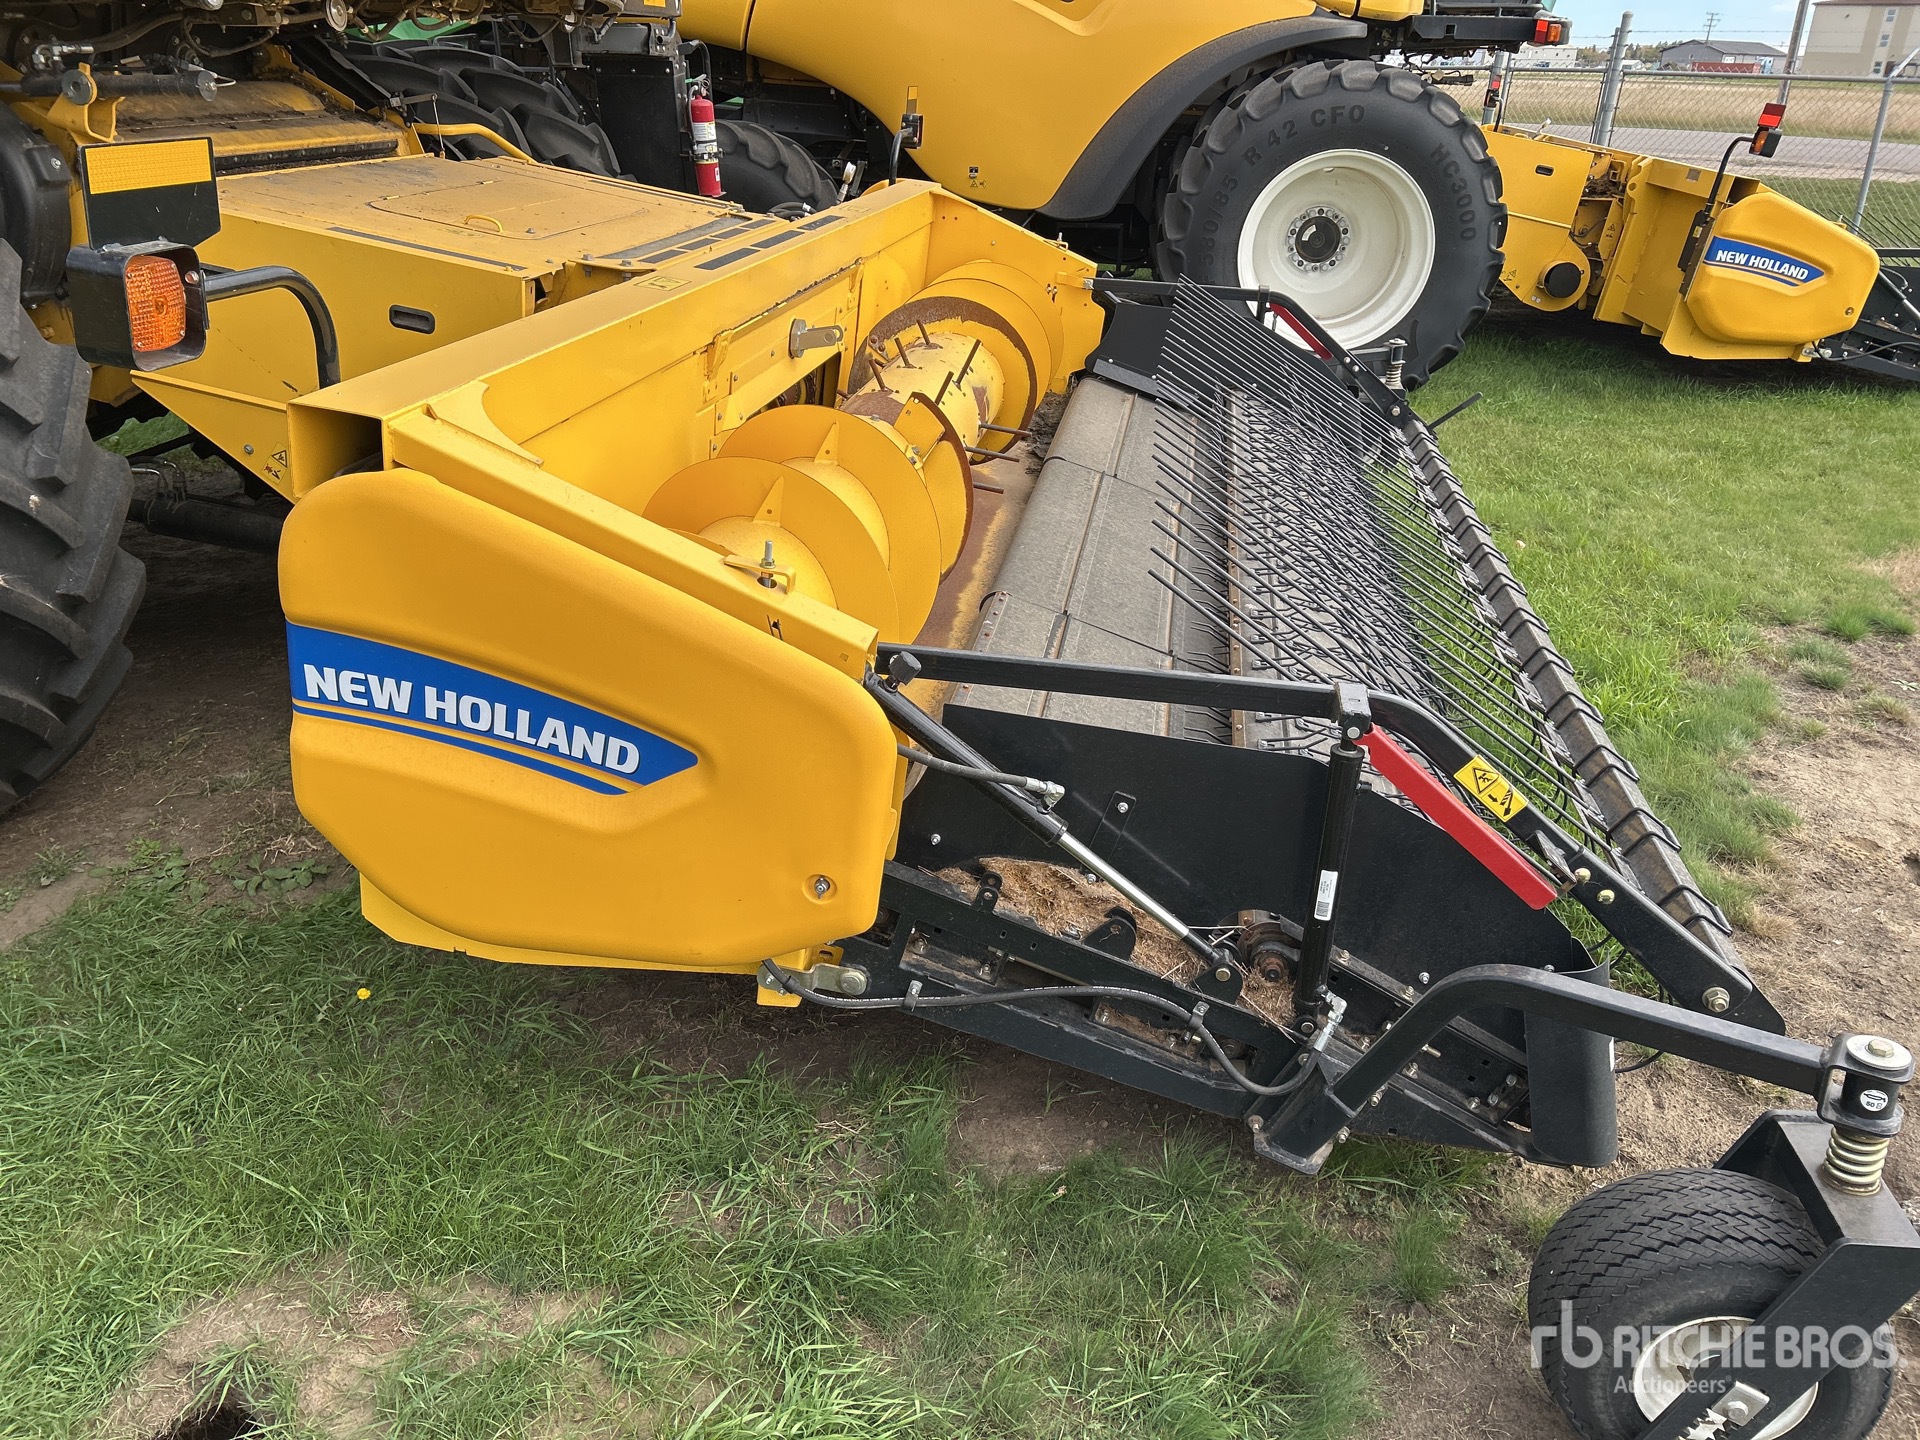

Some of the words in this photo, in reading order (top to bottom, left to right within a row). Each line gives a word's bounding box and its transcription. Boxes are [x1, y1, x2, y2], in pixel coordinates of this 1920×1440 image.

[1241, 145, 1264, 167] R
[1267, 119, 1299, 148] 42
[1311, 104, 1366, 127] CFO
[1429, 142, 1477, 241] HC3000
[1716, 249, 1748, 264] NEW
[1748, 256, 1809, 280] HOLLAND
[303, 663, 413, 714] NEW
[424, 685, 641, 775] HOLLAND
